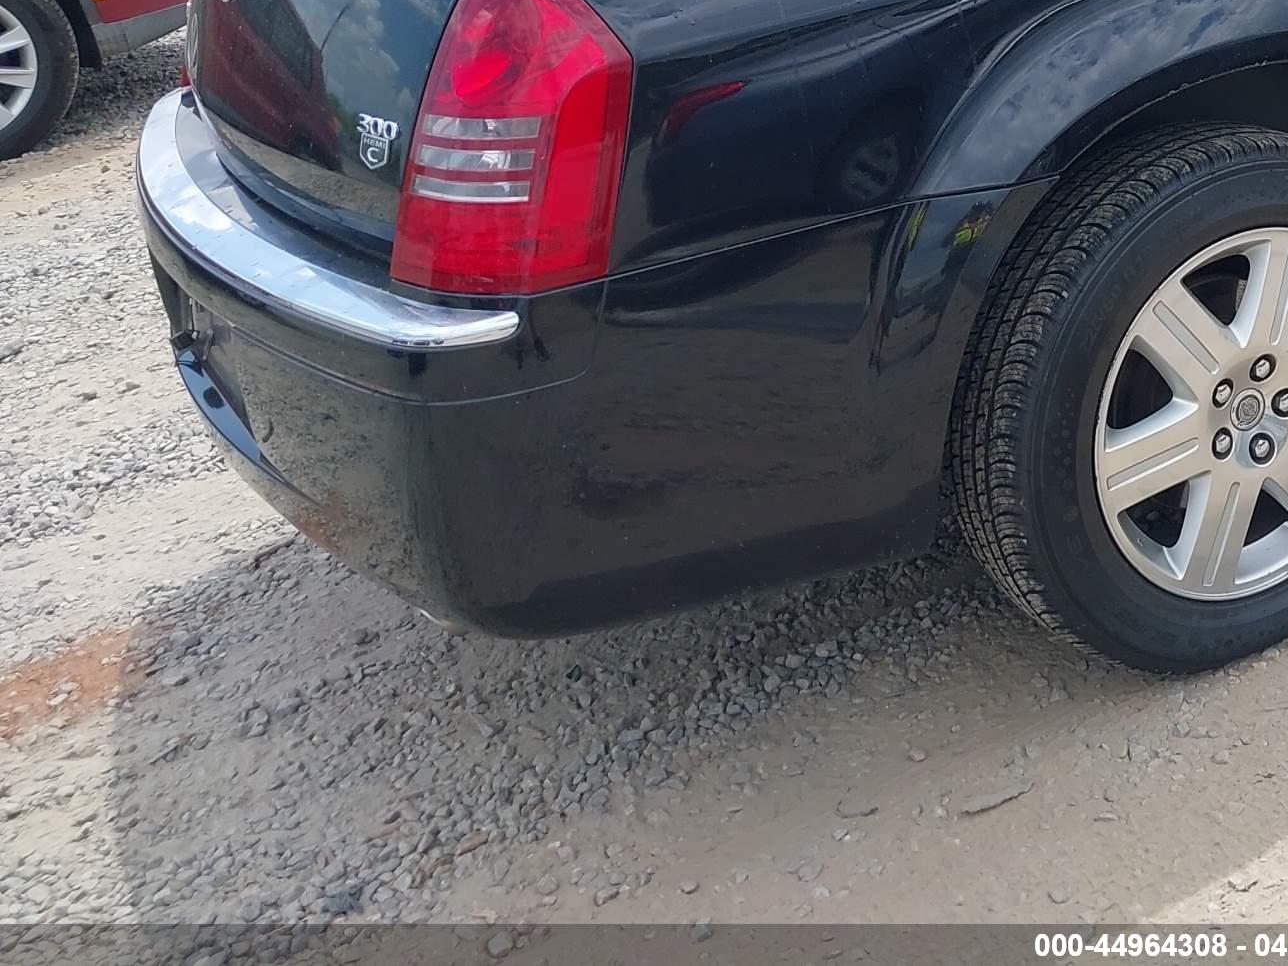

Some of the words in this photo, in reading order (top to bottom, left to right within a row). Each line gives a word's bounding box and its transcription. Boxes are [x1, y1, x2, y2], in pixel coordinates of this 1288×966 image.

[356, 113, 398, 141] 300
[363, 136, 387, 150] HEMI
[367, 147, 380, 163] C
